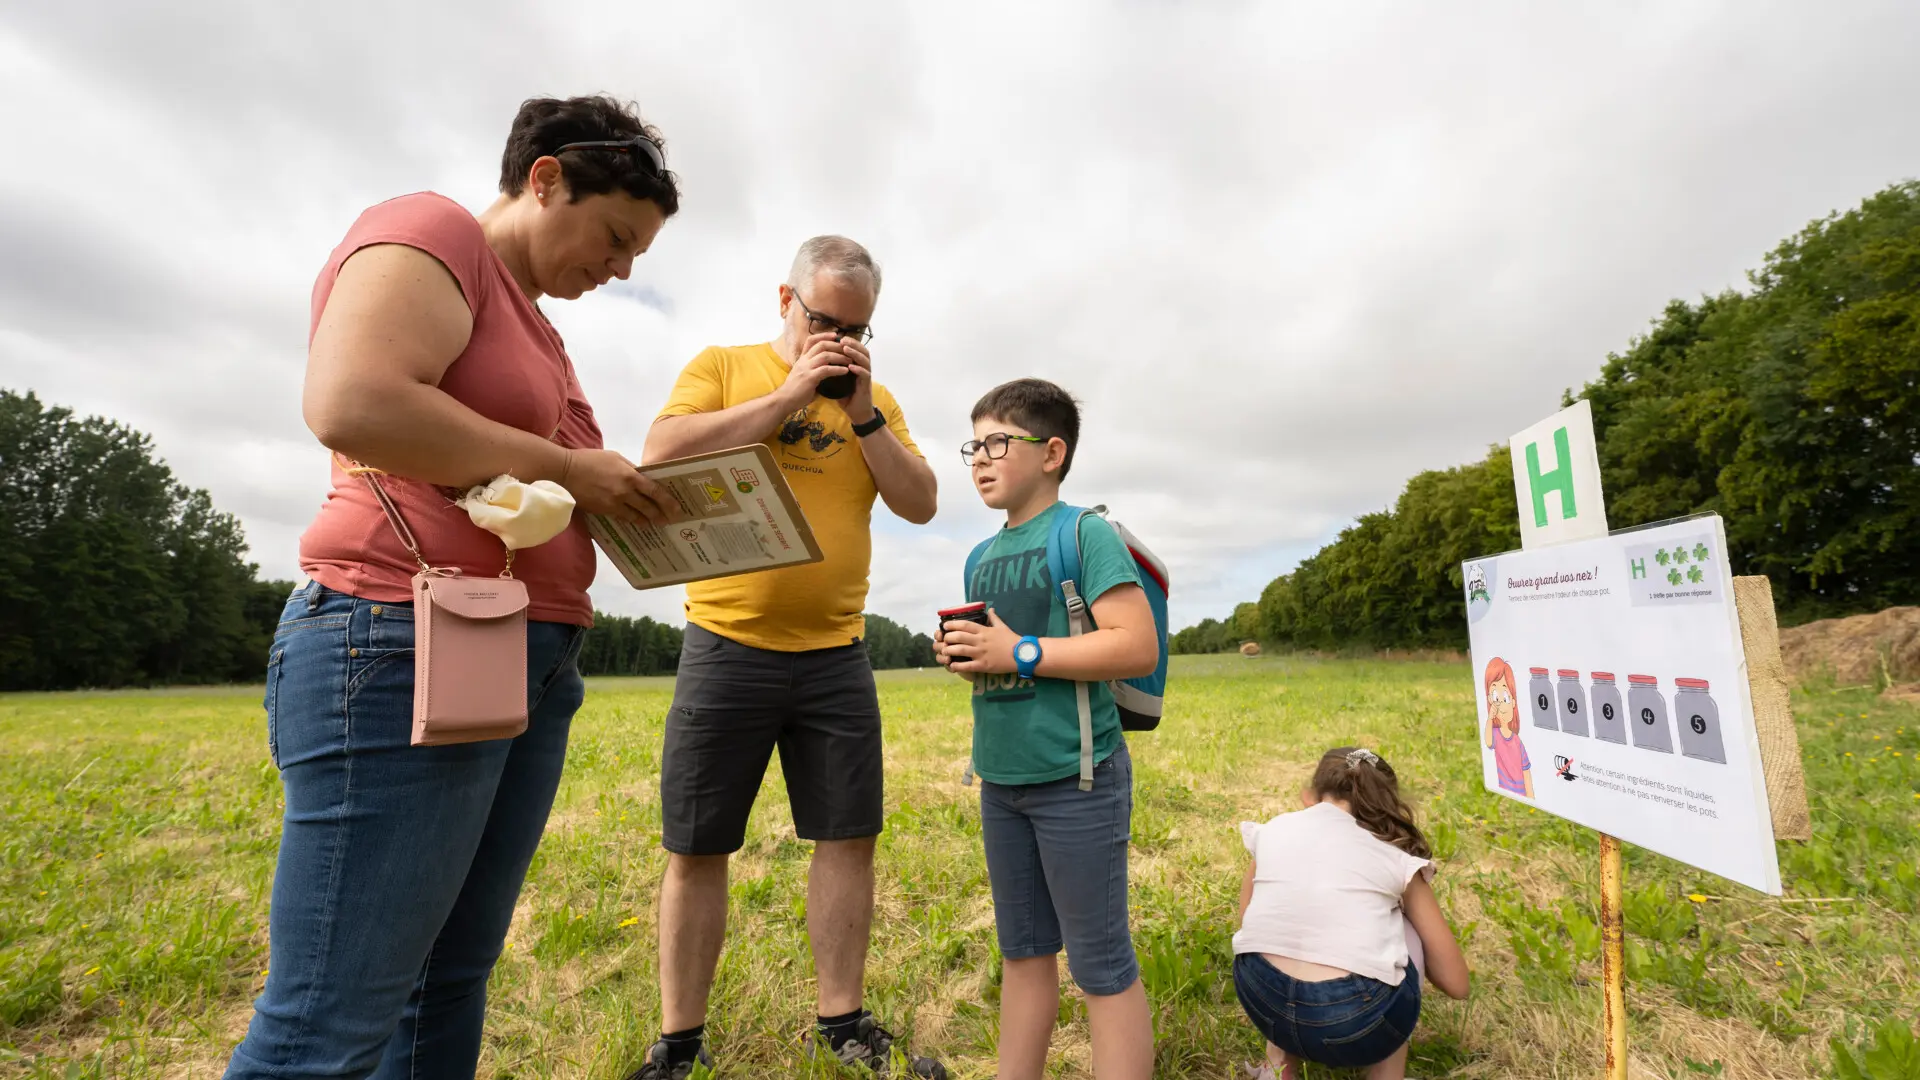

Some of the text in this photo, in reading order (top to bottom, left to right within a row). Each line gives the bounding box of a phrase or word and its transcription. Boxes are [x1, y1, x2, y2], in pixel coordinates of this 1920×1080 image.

[782, 462, 824, 474] QUECHUA
[1525, 426, 1577, 528] H
[1508, 577, 1534, 589] Ouvrez
[1535, 572, 1558, 590] grand
[1561, 574, 1574, 583] vos
[1576, 570, 1592, 581] nez
[1631, 558, 1646, 579] H
[1580, 589, 1598, 597] chaque
[1540, 696, 1702, 732] 1 2 3 4 5
[1606, 768, 1625, 779] certain
[1627, 774, 1665, 789] ingrédients
[1667, 784, 1682, 794] sont
[1596, 778, 1621, 792] attention
[1638, 790, 1649, 799] pas
[1651, 794, 1685, 809] renverser
[1687, 802, 1698, 812] les
[1699, 807, 1719, 819] pots.
